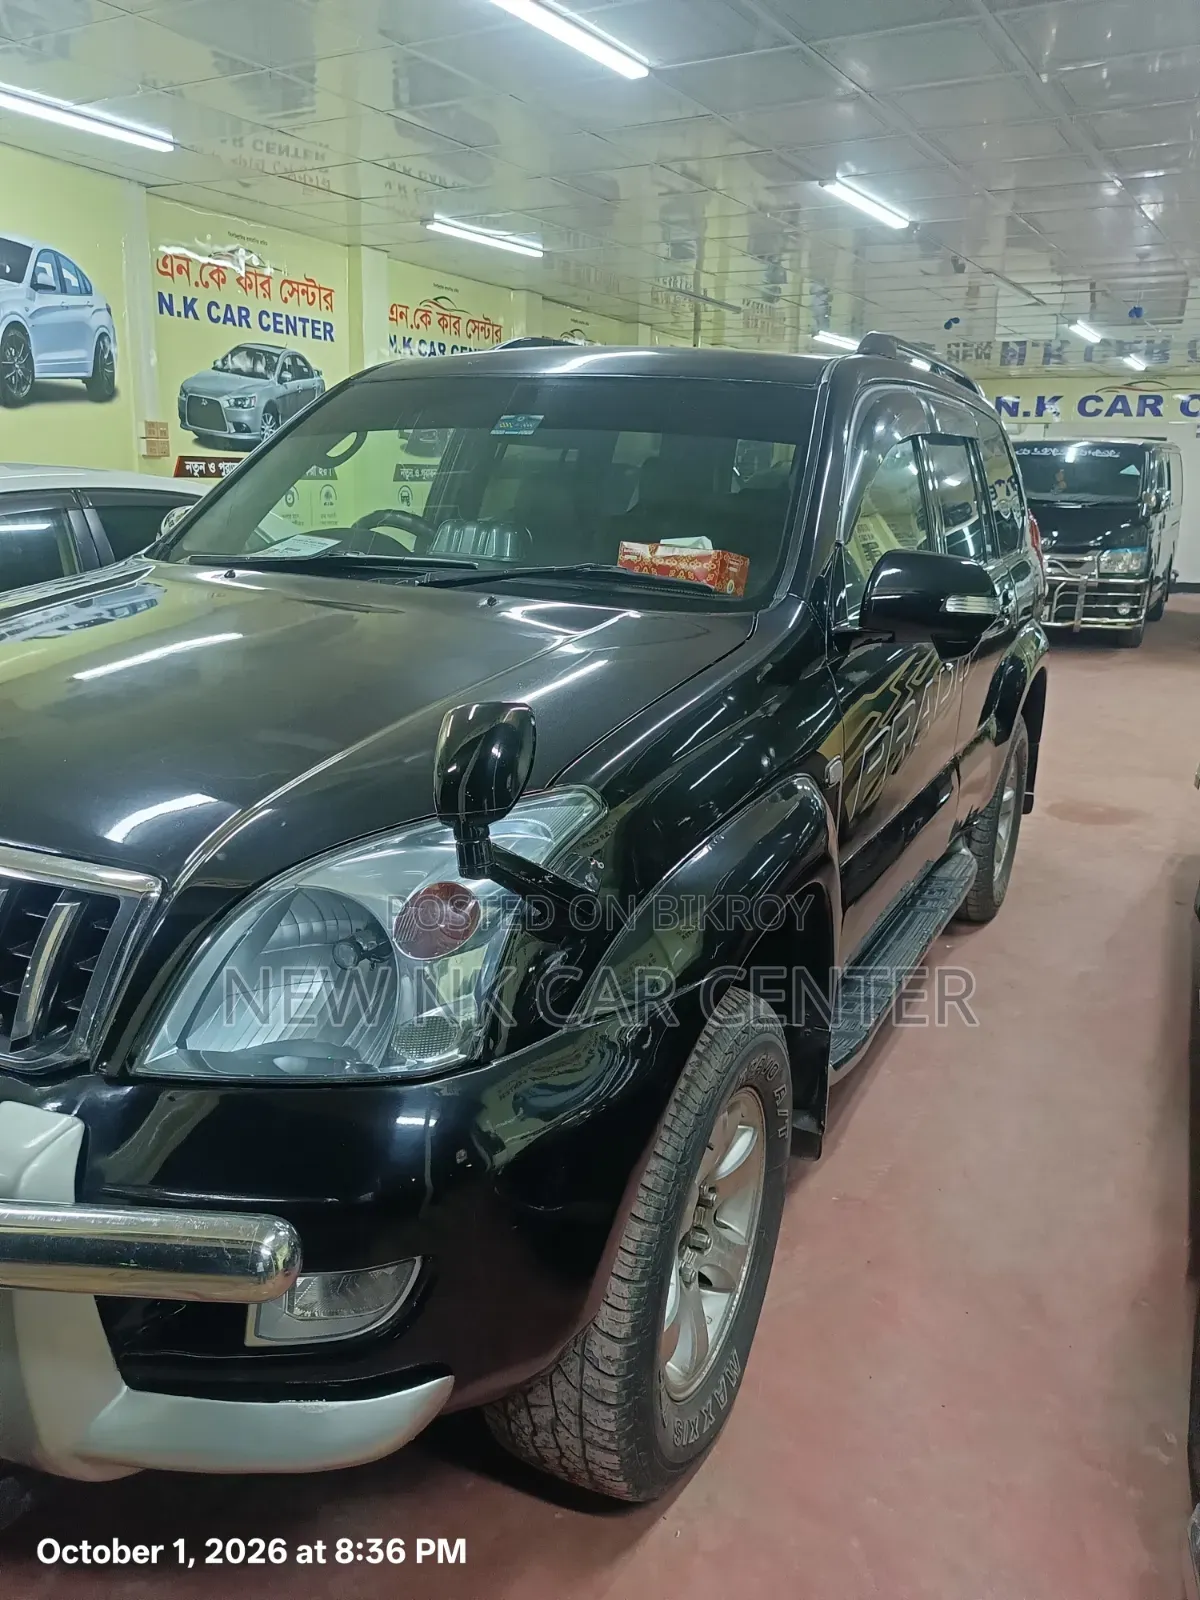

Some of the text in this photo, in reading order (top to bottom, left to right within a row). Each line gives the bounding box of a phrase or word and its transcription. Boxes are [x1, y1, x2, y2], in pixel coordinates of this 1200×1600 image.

[156, 253, 335, 313] এন.কে কার সেন্টার
[157, 291, 335, 343] N.K CAR CENTER
[437, 311, 462, 338] কার
[418, 339, 447, 357] CAR
[1077, 394, 1164, 418] CAR
[673, 1347, 741, 1447] MAXXIS
